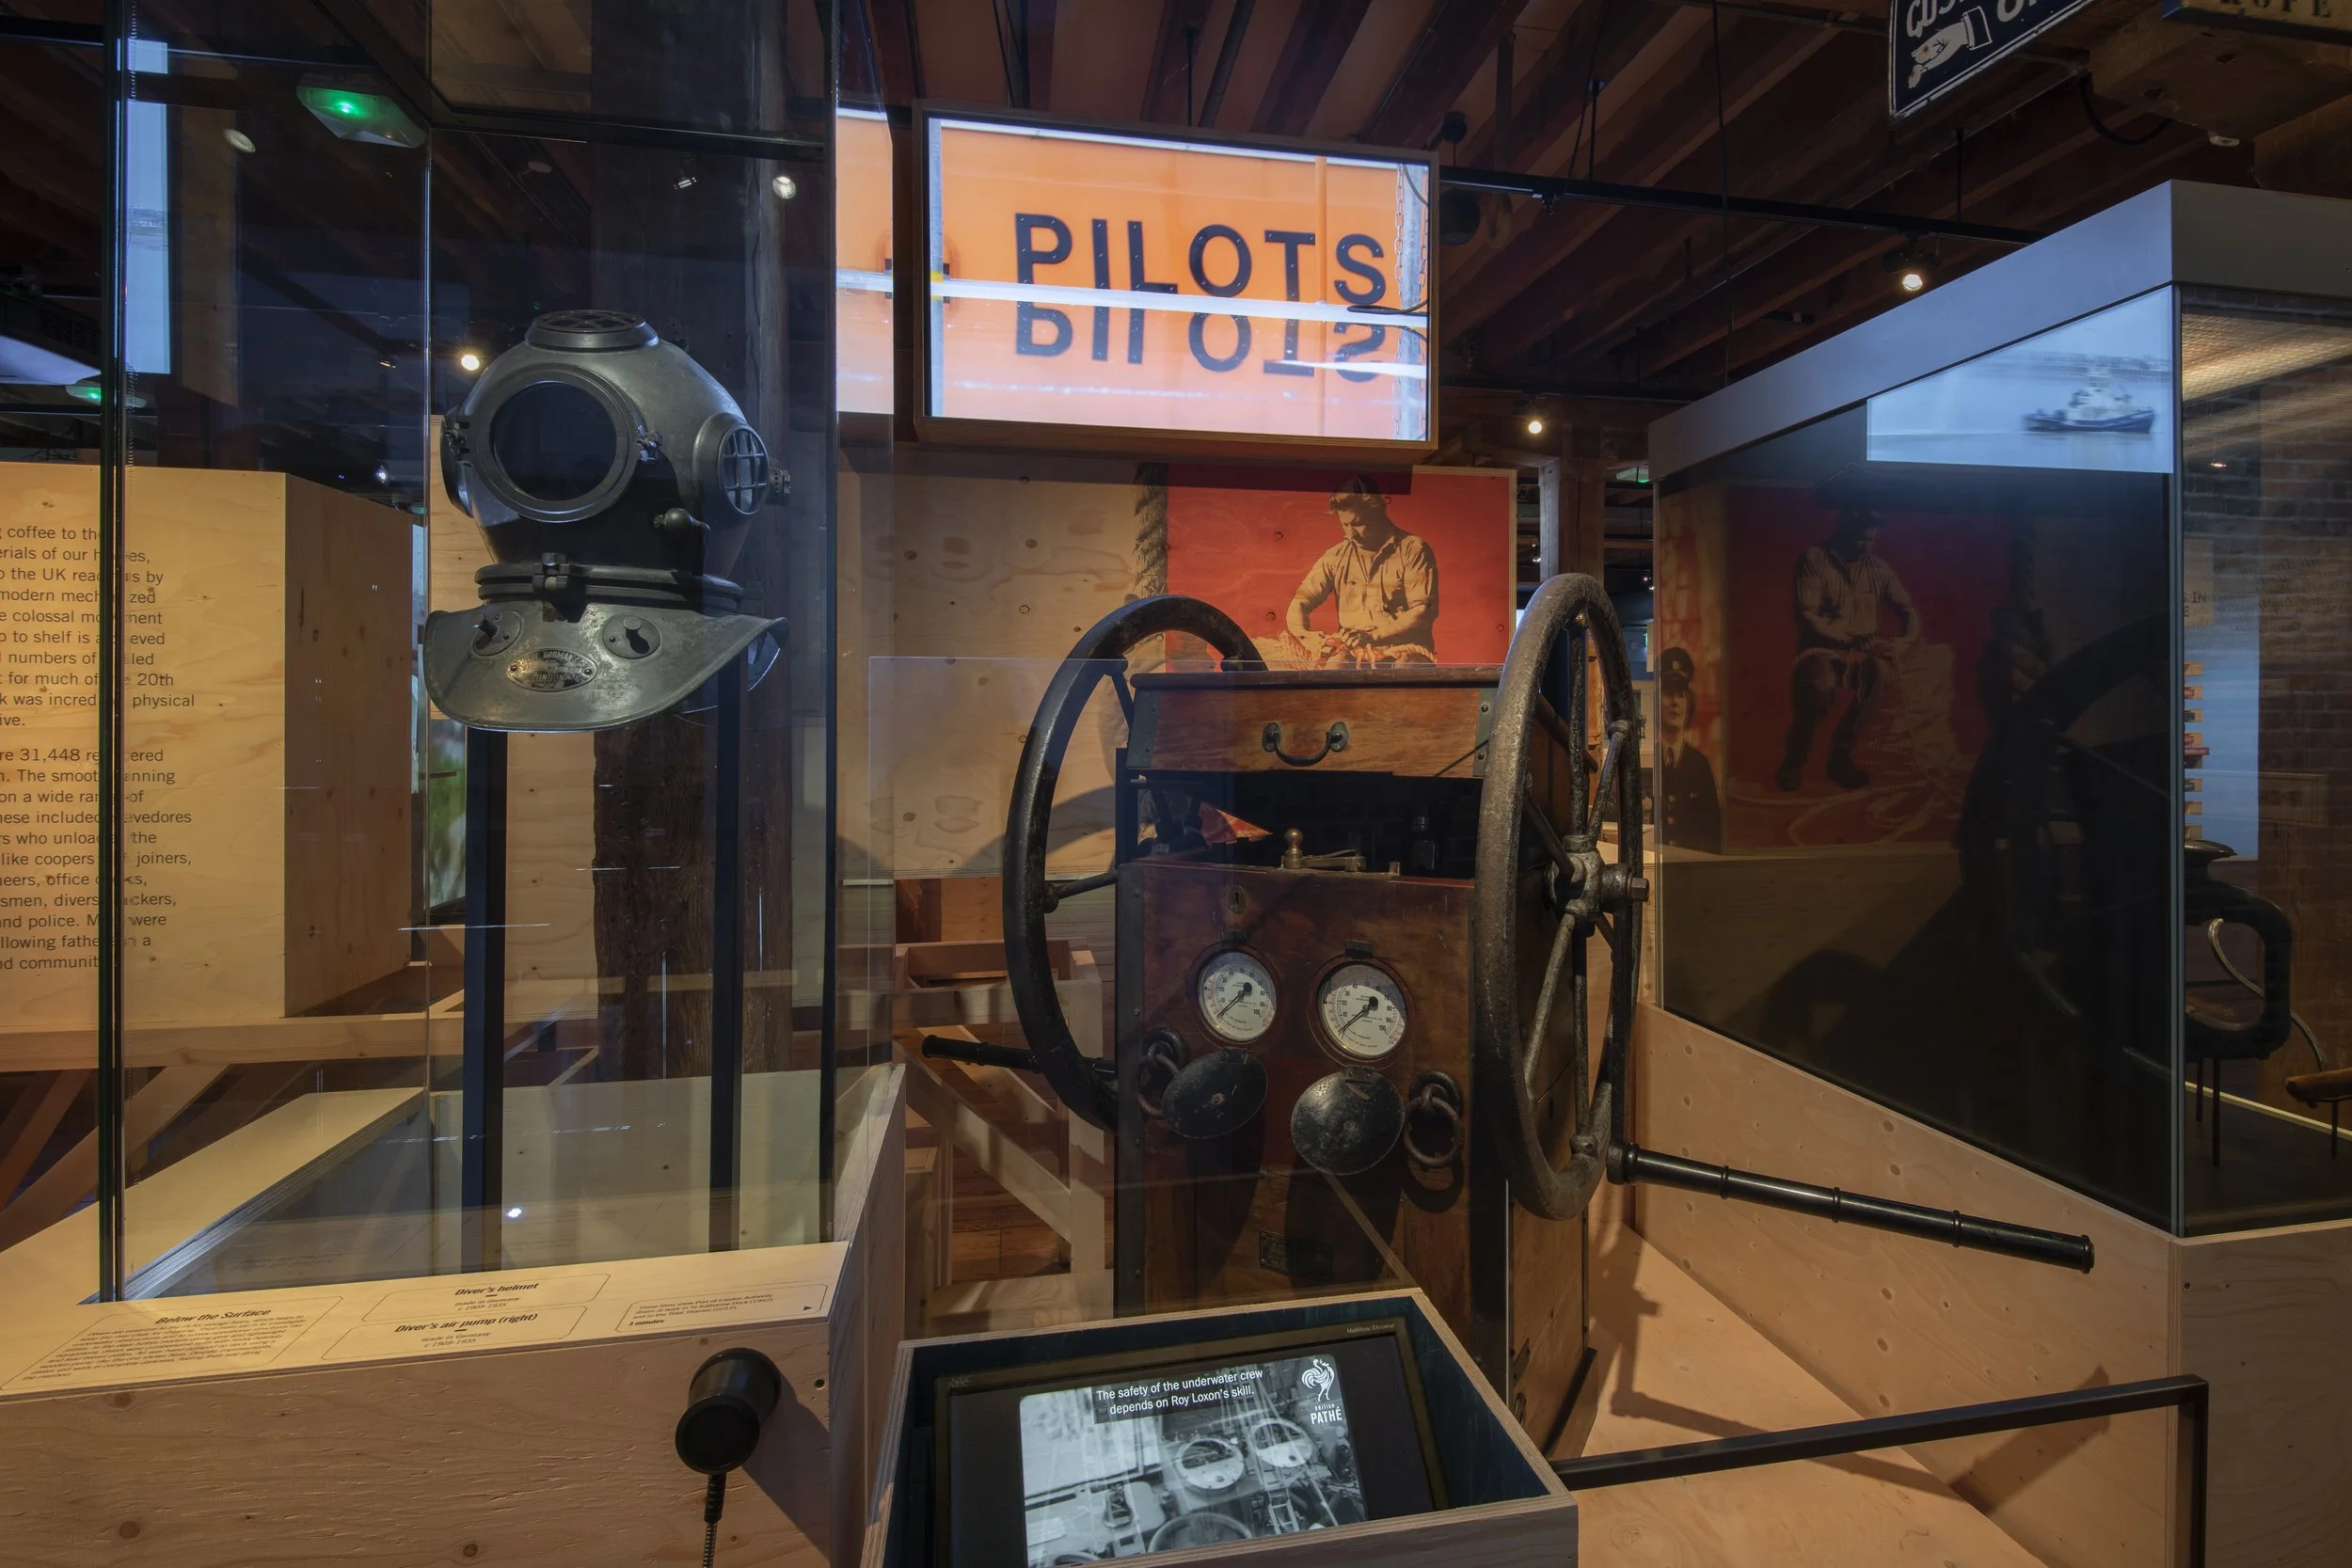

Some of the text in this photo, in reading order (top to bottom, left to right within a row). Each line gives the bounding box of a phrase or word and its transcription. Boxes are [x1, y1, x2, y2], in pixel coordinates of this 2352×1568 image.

[1014, 212, 1387, 305] PILOTS
[8, 525, 101, 540] coffee to th
[41, 547, 57, 561] of
[62, 550, 88, 561] our
[10, 567, 36, 580] the
[43, 568, 67, 581] UK
[147, 570, 164, 585] by
[13, 610, 74, 623] colossal
[13, 630, 28, 642] to
[33, 630, 72, 643] shelf
[78, 631, 90, 643] is
[8, 652, 97, 665] numbers of
[8, 672, 29, 685] for
[35, 673, 78, 685] much
[85, 673, 100, 685] of
[137, 673, 174, 686] 20th
[13, 695, 42, 705] was
[133, 694, 195, 708] physical
[20, 749, 81, 763] 31,448
[17, 769, 46, 782] The
[24, 793, 31, 803] a
[38, 790, 73, 803] wide
[130, 790, 144, 803] of
[16, 832, 47, 845] who
[131, 832, 157, 844] the
[2, 852, 192, 867] like coopers joiners,
[46, 873, 89, 886] office
[0, 895, 47, 908] smen,
[28, 914, 80, 930] police.
[131, 915, 167, 926] were
[142, 937, 151, 946] a
[454, 1282, 539, 1295] Diver's helmet
[155, 1316, 198, 1324] Below
[221, 1309, 272, 1319] Surface
[395, 1323, 437, 1333] Diver's
[459, 1317, 496, 1328] pump
[498, 1313, 538, 1324] (right)
[1097, 1370, 1263, 1402] The safety of the underwater crew
[1109, 1385, 1254, 1416] depends on Roy Loxon's skill.
[1310, 1406, 1343, 1425] PATHÉ
